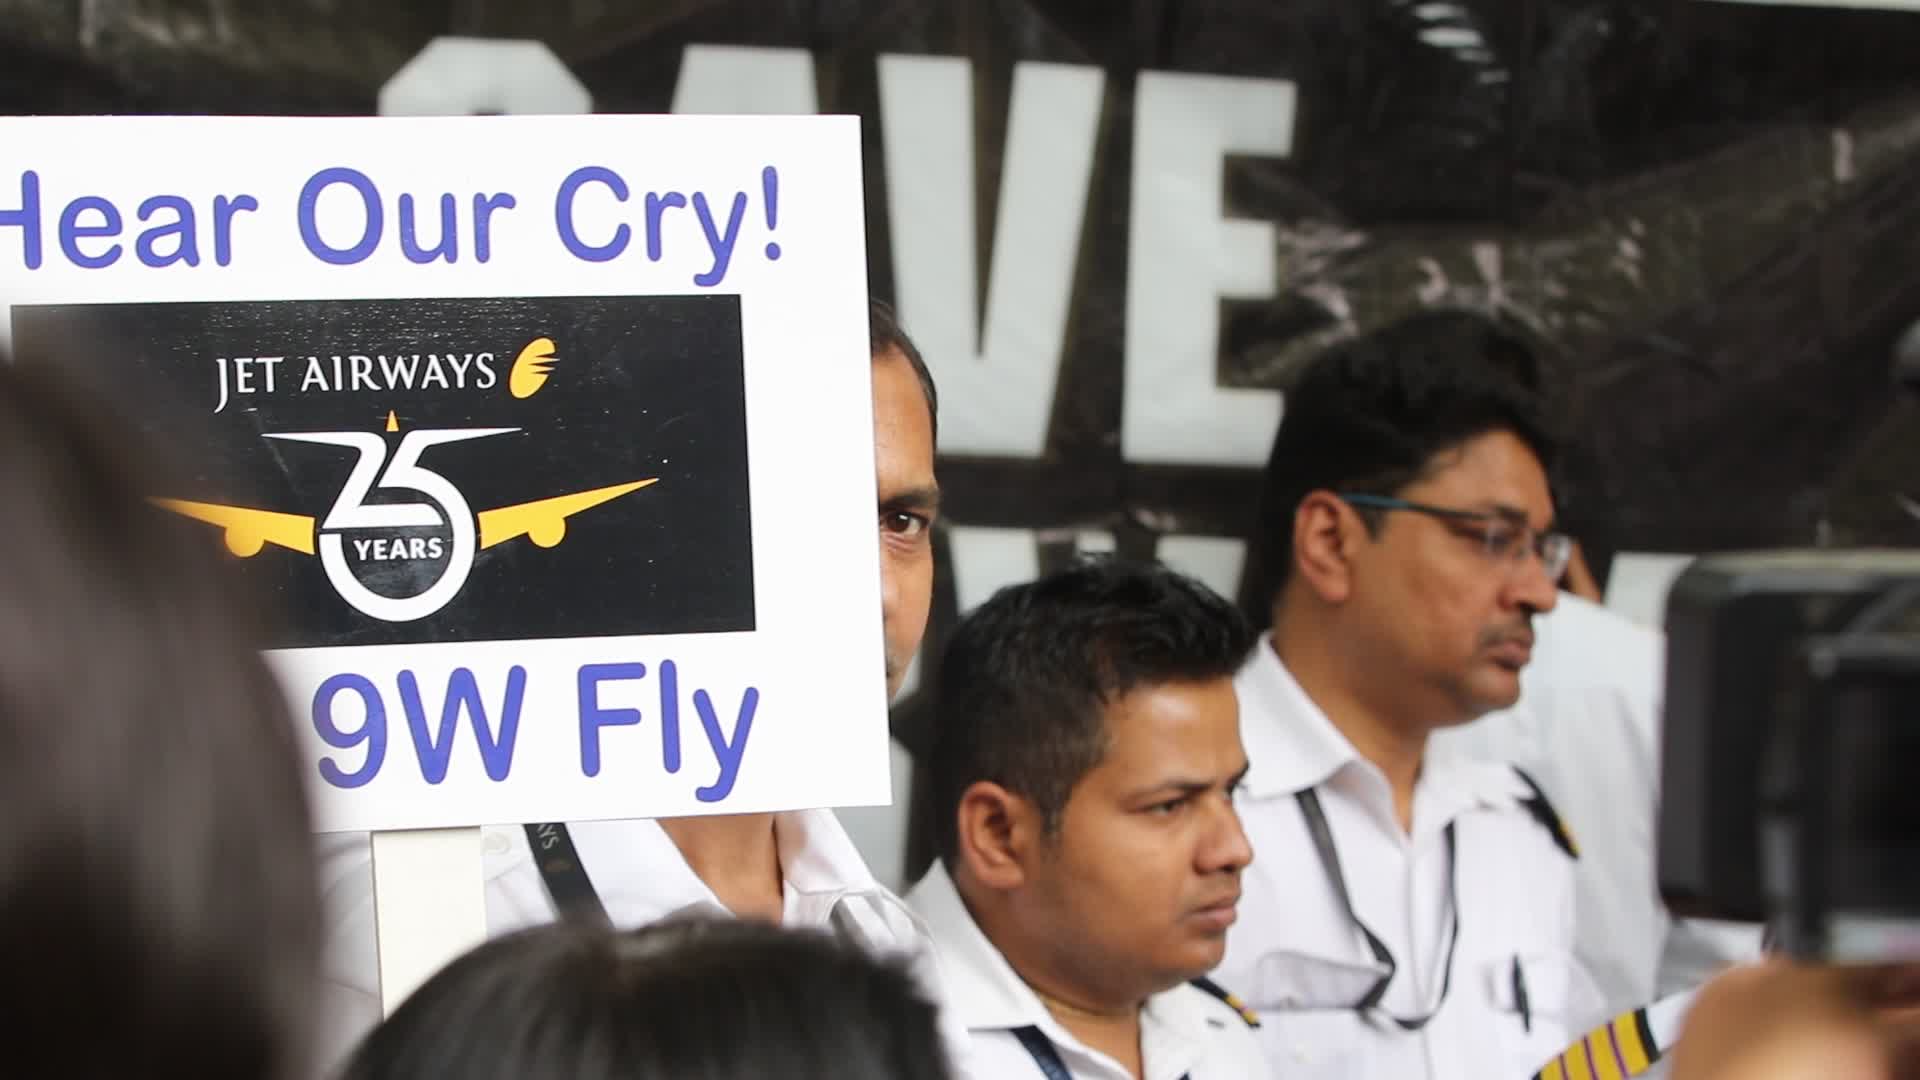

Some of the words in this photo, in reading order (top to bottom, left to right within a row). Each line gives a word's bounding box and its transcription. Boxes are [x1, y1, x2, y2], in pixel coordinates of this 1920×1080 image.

[298, 166, 515, 265] Our
[556, 166, 783, 287] Cry!
[378, 36, 1297, 467] VE
[214, 355, 285, 414] JET
[300, 352, 497, 392] AIRWAYS
[261, 427, 522, 622] 25
[353, 537, 443, 562] YEARS
[311, 664, 528, 789] 9W
[576, 659, 760, 803] Fly
